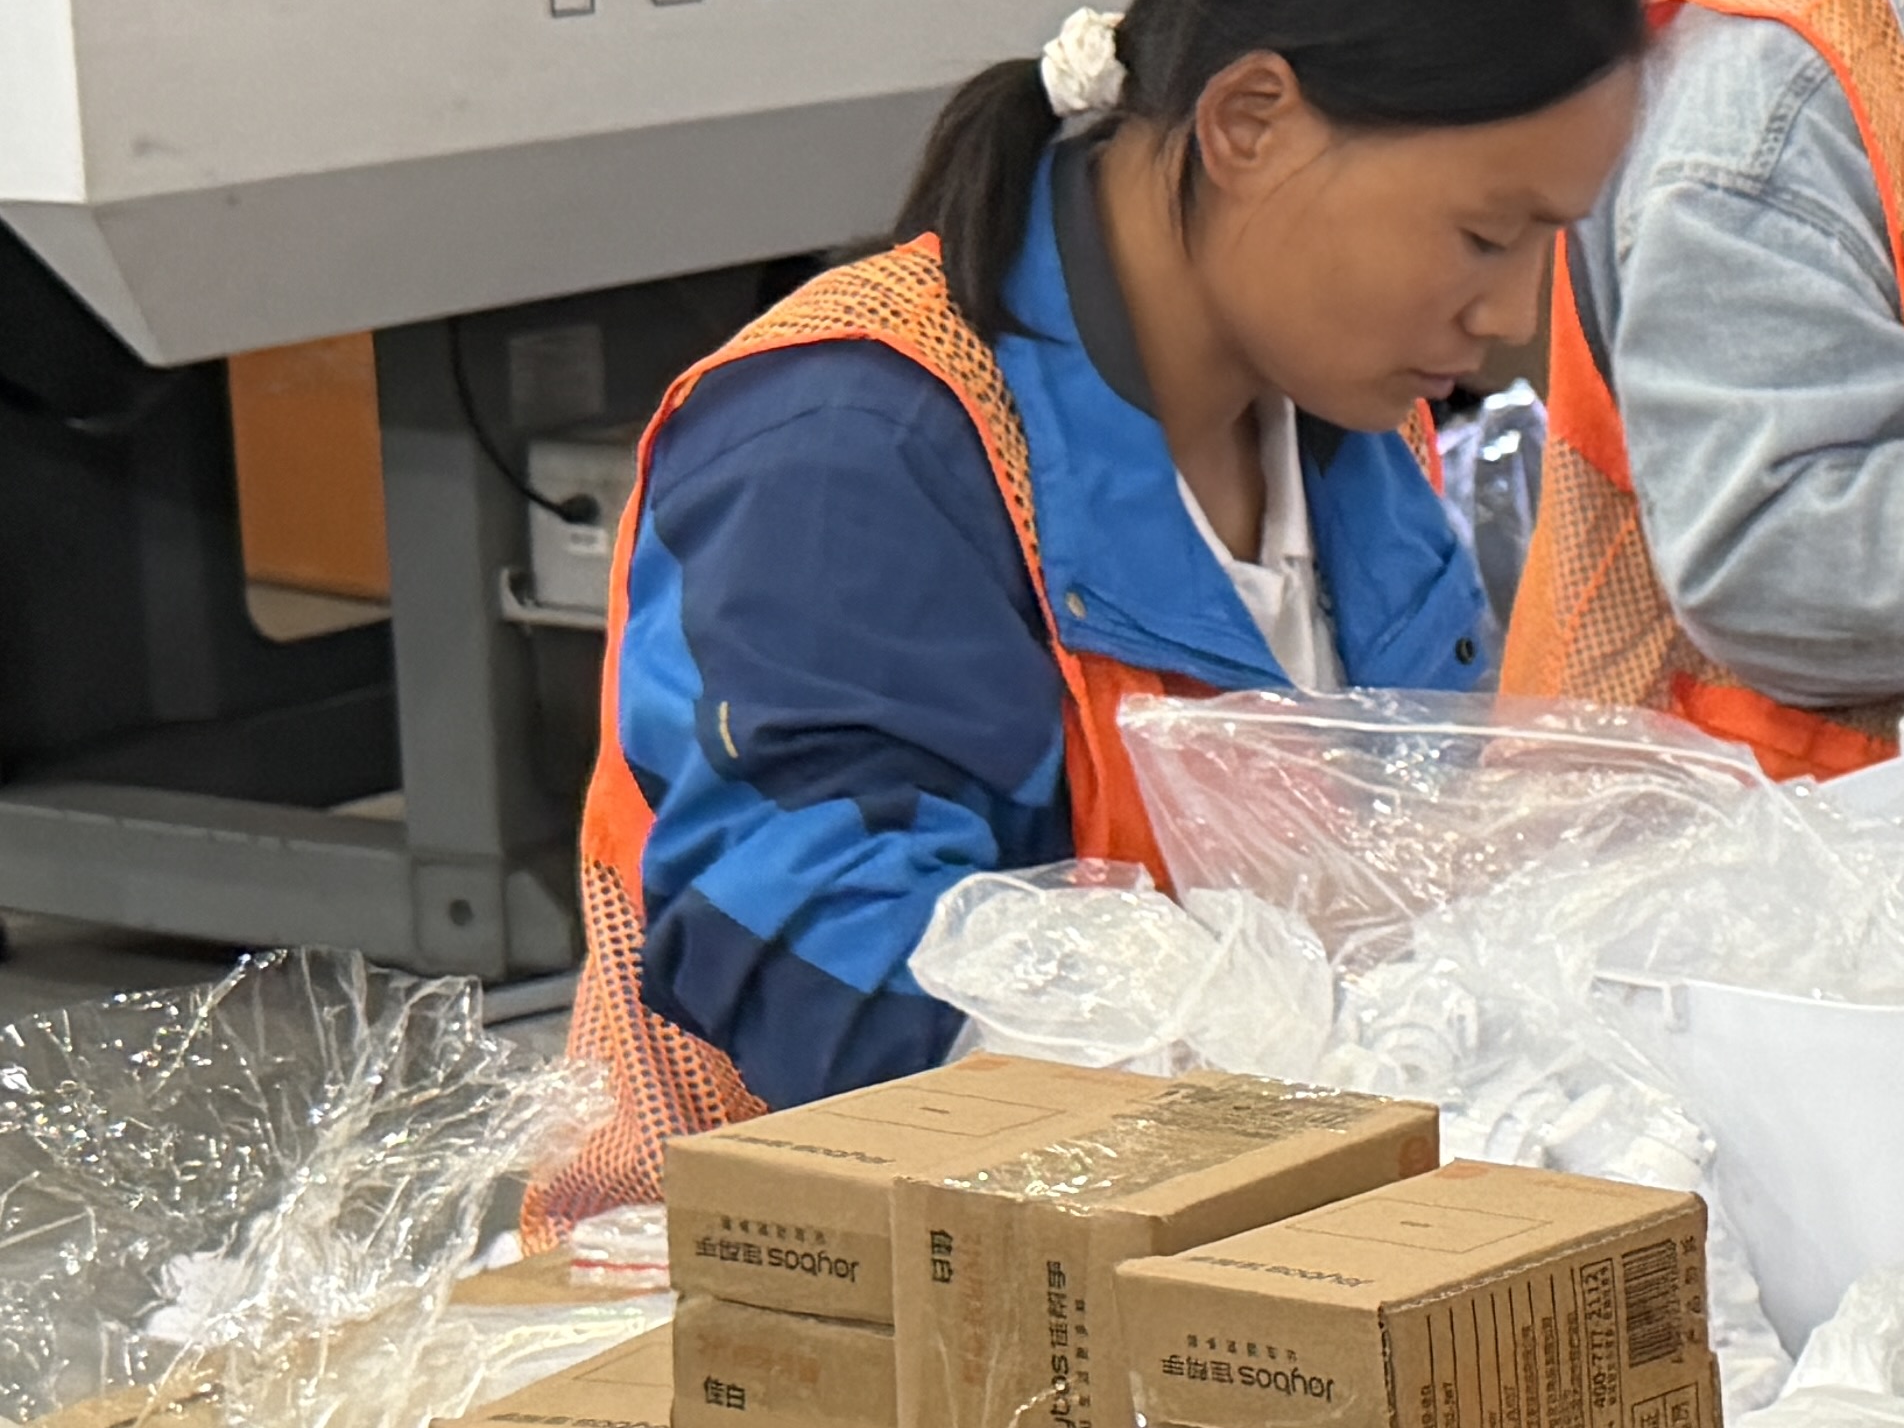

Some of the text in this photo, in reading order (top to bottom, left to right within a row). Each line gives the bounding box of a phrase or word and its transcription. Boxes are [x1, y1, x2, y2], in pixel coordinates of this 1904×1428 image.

[767, 1246, 860, 1282] Joybos
[930, 1229, 953, 1283] 佳白
[703, 1376, 746, 1410] 佳白
[1238, 1365, 1334, 1402] Joybos
